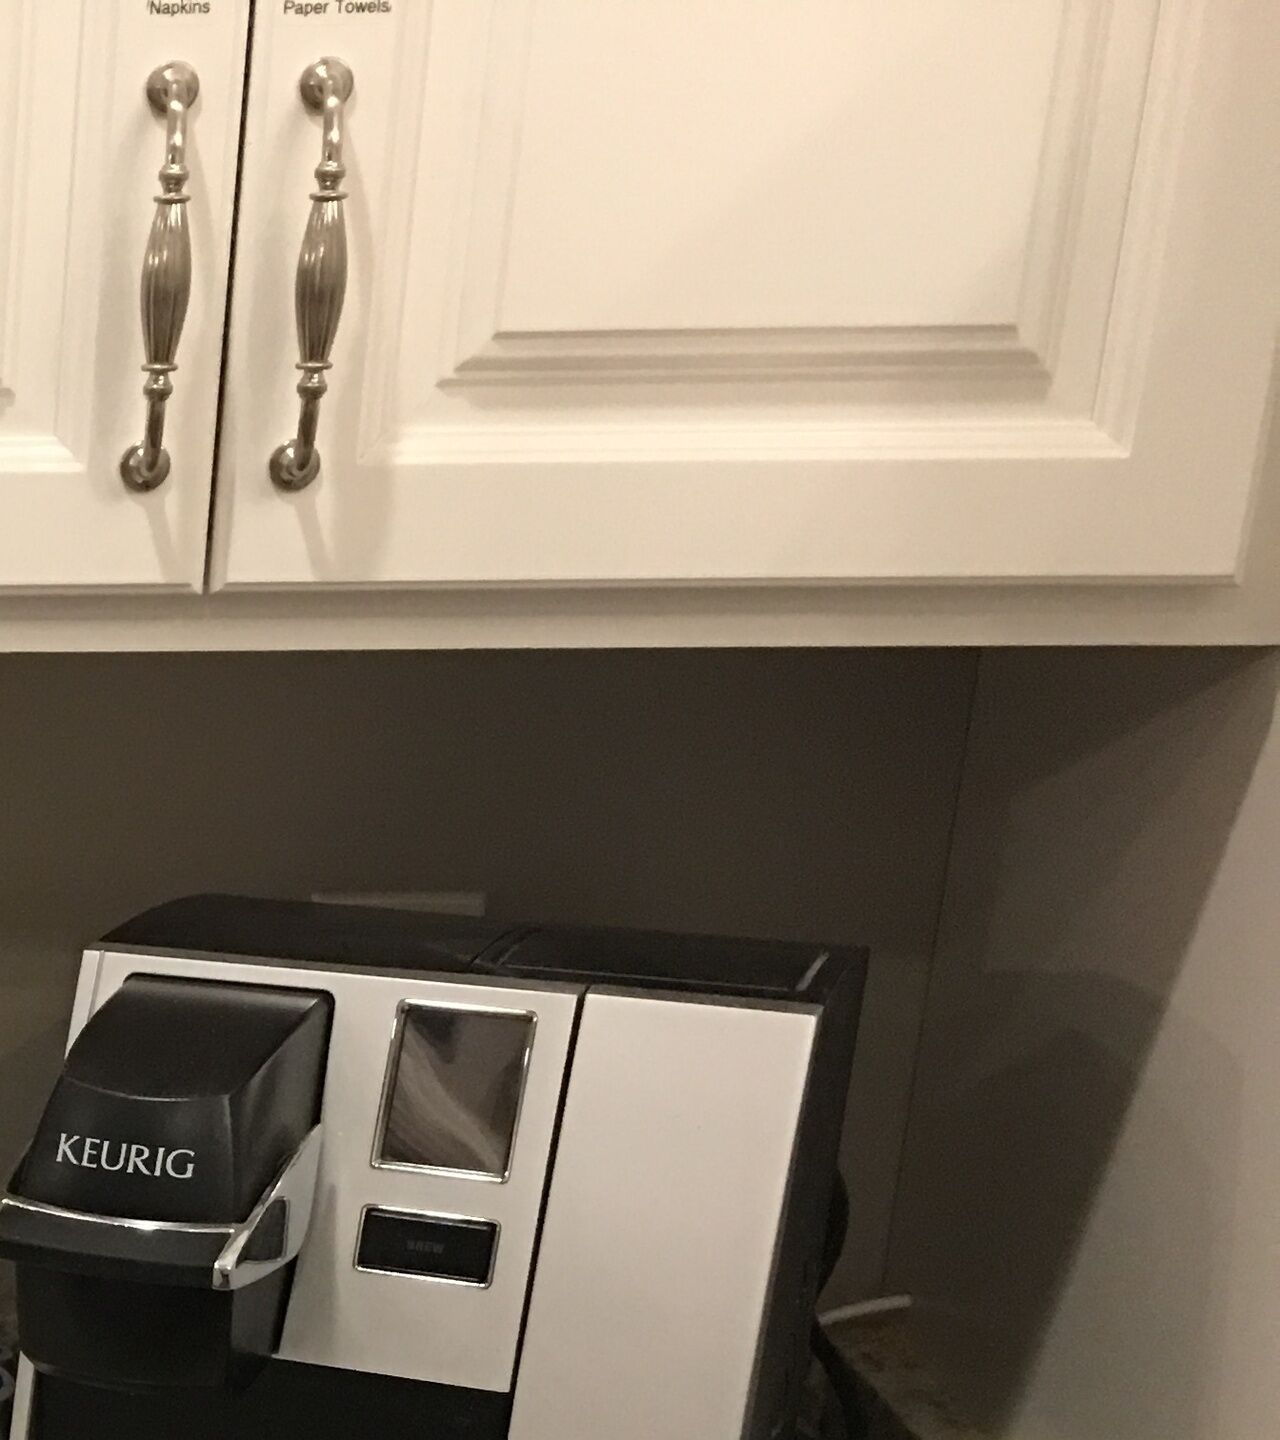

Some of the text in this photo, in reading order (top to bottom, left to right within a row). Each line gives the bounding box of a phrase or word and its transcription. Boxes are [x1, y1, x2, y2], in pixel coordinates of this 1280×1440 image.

[149, 0, 210, 16] Napkins
[282, 0, 391, 17] Paper Towels
[55, 1133, 196, 1179] KEURIG
